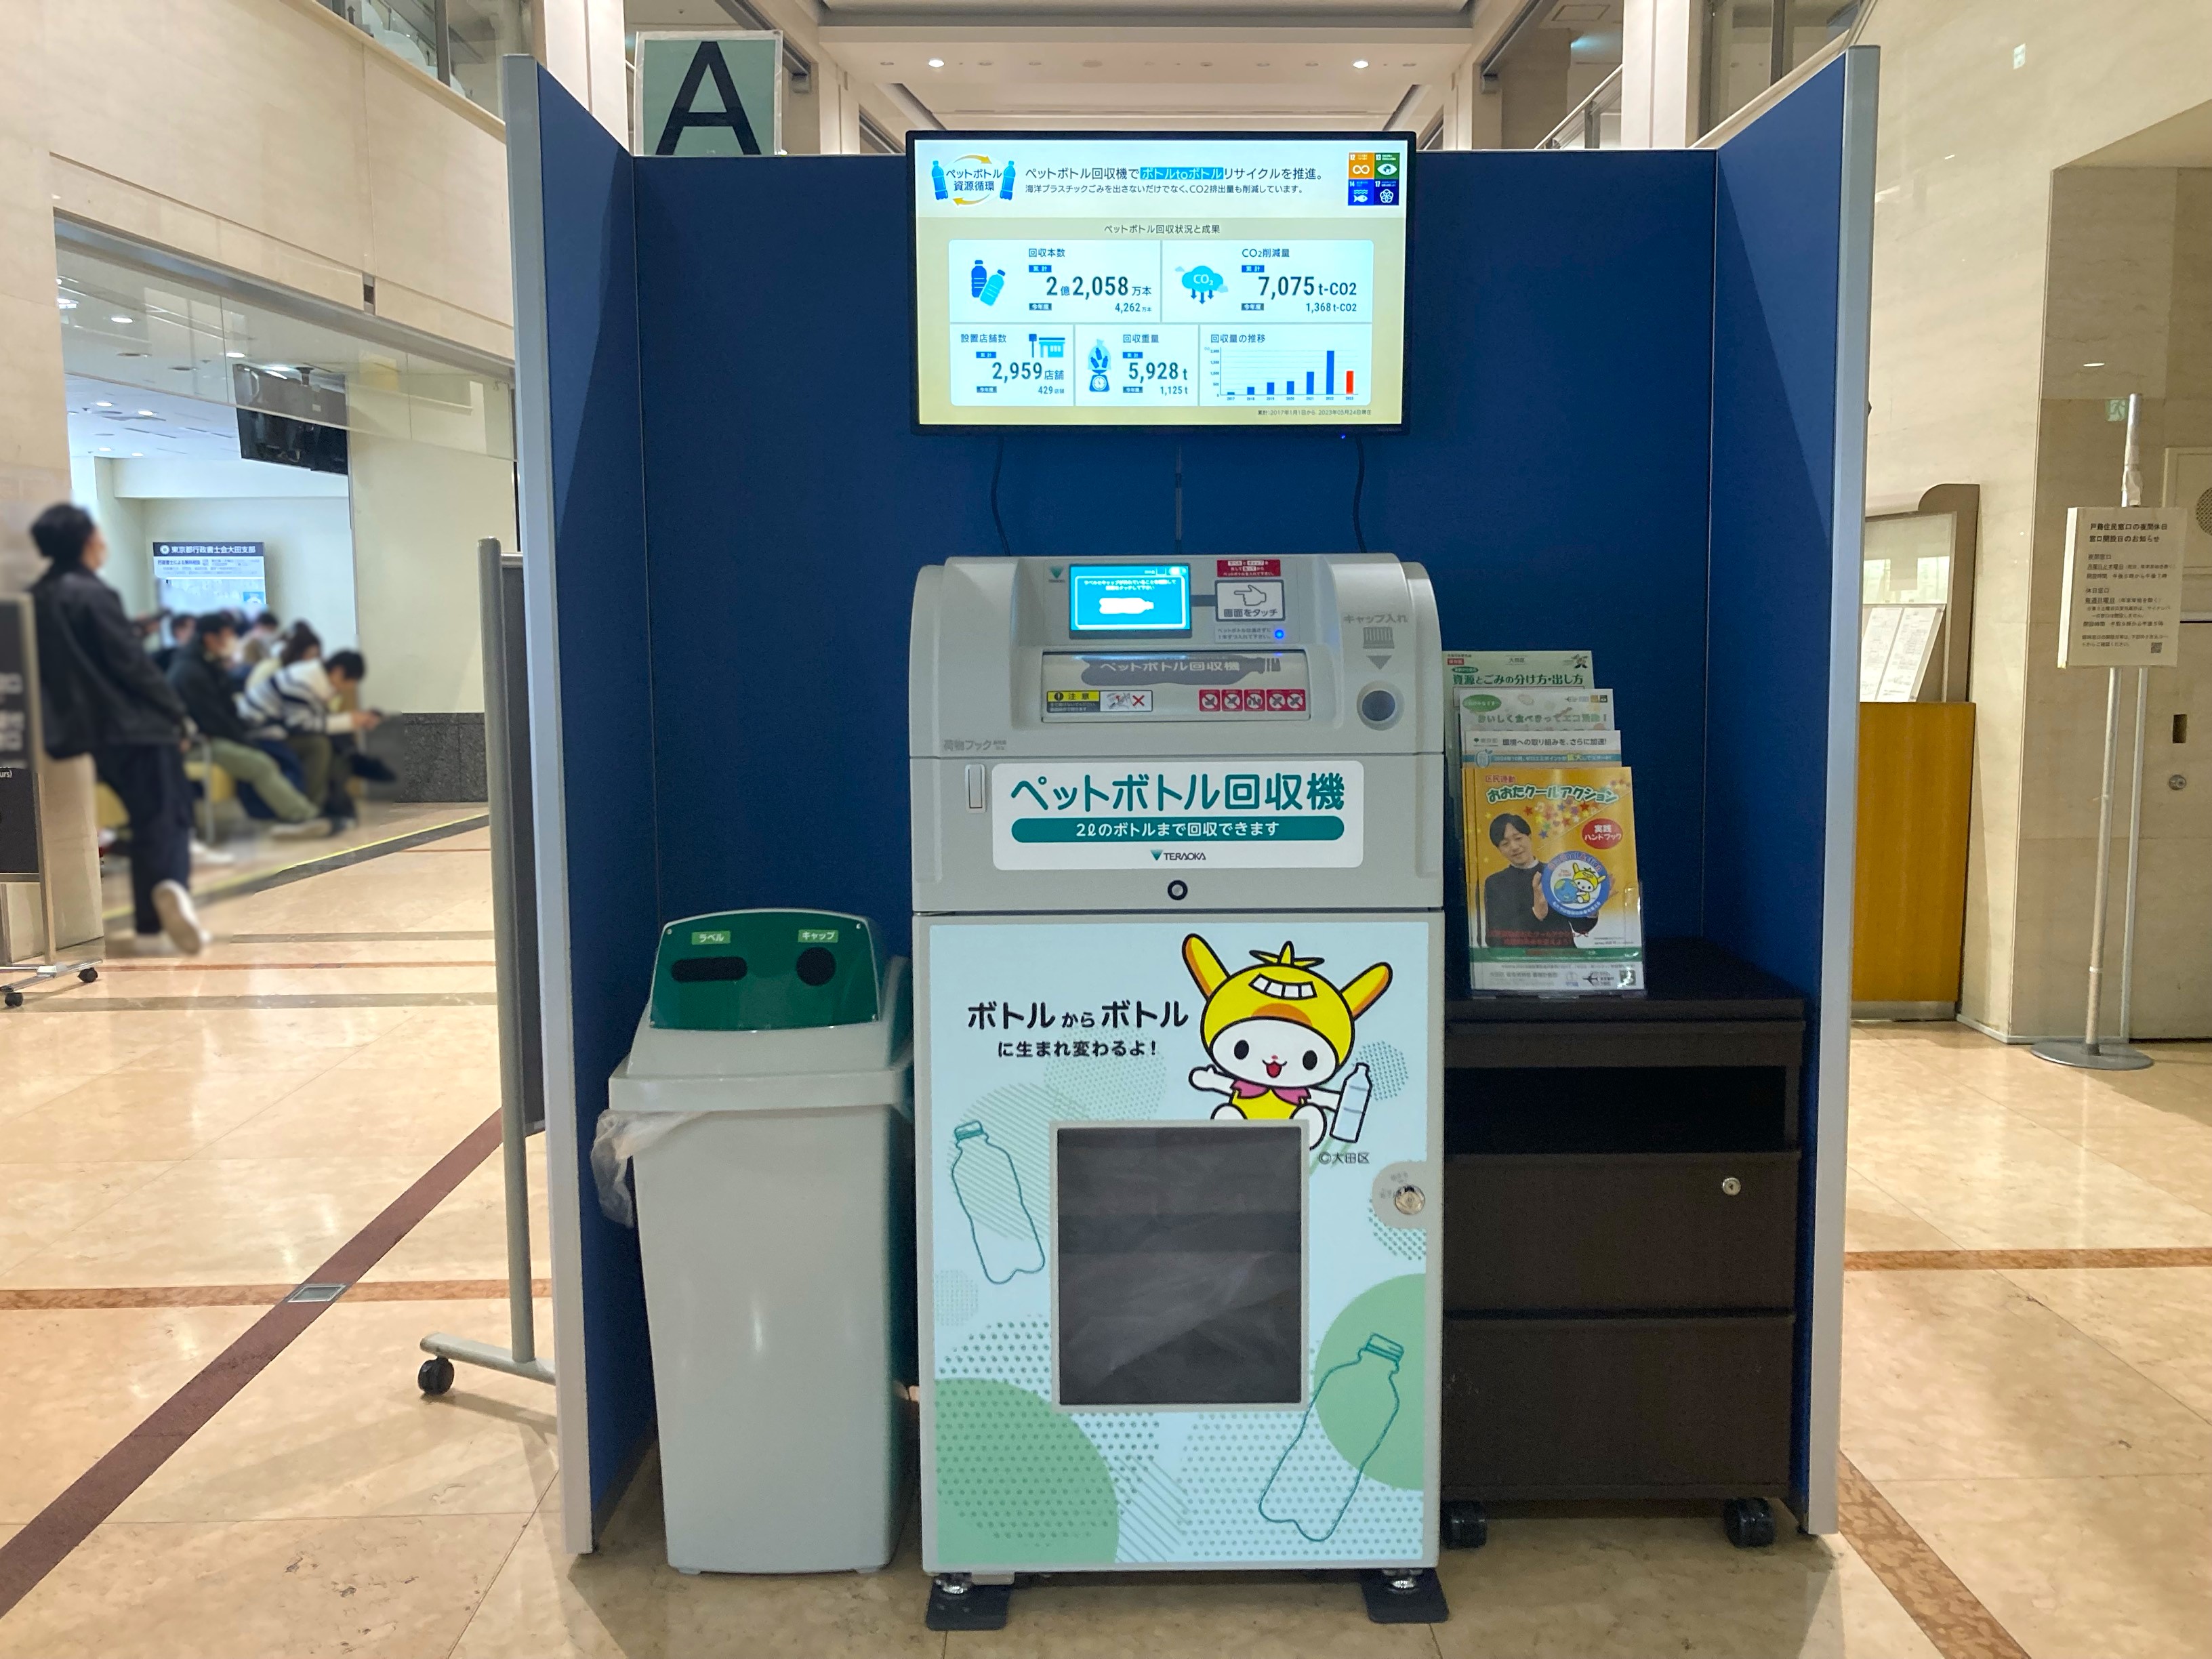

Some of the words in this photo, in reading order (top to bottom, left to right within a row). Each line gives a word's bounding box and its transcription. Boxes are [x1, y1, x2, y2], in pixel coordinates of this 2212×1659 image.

[655, 41, 762, 155] A
[946, 168, 1002, 179] ペットボトル
[1025, 167, 1322, 180] ペットボトル回収機でボトルtoボトルリサイクルを推進。
[954, 181, 995, 191] 資源循環
[1104, 224, 1221, 234] ペットボトル回収状況と成果
[1028, 248, 1065, 258] 回収本数
[1258, 276, 1315, 300] 7,075
[1318, 283, 1357, 296] t-CO2
[1115, 303, 1152, 314] 4,262万本
[1305, 303, 1332, 314] 1,368
[1332, 303, 1357, 312] t-CO2
[960, 334, 1007, 344] 設置店舗数
[1123, 334, 1160, 344] 回収重量
[1210, 334, 1266, 344] 回収量の推移
[1128, 362, 1179, 384] 5,928
[1183, 369, 1188, 380] t
[1160, 386, 1183, 396] 1,125
[171, 546, 256, 554] 東京都行政書士会大田支部
[1223, 609, 1278, 617] 画面をタッチ
[1344, 613, 1408, 623] キャップ入れ
[1101, 661, 1240, 672] ペットボトル回収機
[1452, 674, 1584, 684] 資源とごみの分け方・出し方
[1485, 775, 1517, 783] 区民運動
[1010, 772, 1345, 812] ペットボトル回収機
[1486, 784, 1620, 805] おおたクールアクション
[1593, 823, 1612, 833] 実践
[1584, 833, 1622, 841] ハンドブック
[1163, 852, 1206, 861] TERAOKA
[699, 933, 724, 943] ラベル
[802, 931, 836, 941] キャップ
[1318, 1151, 1370, 1164] ©大田区
